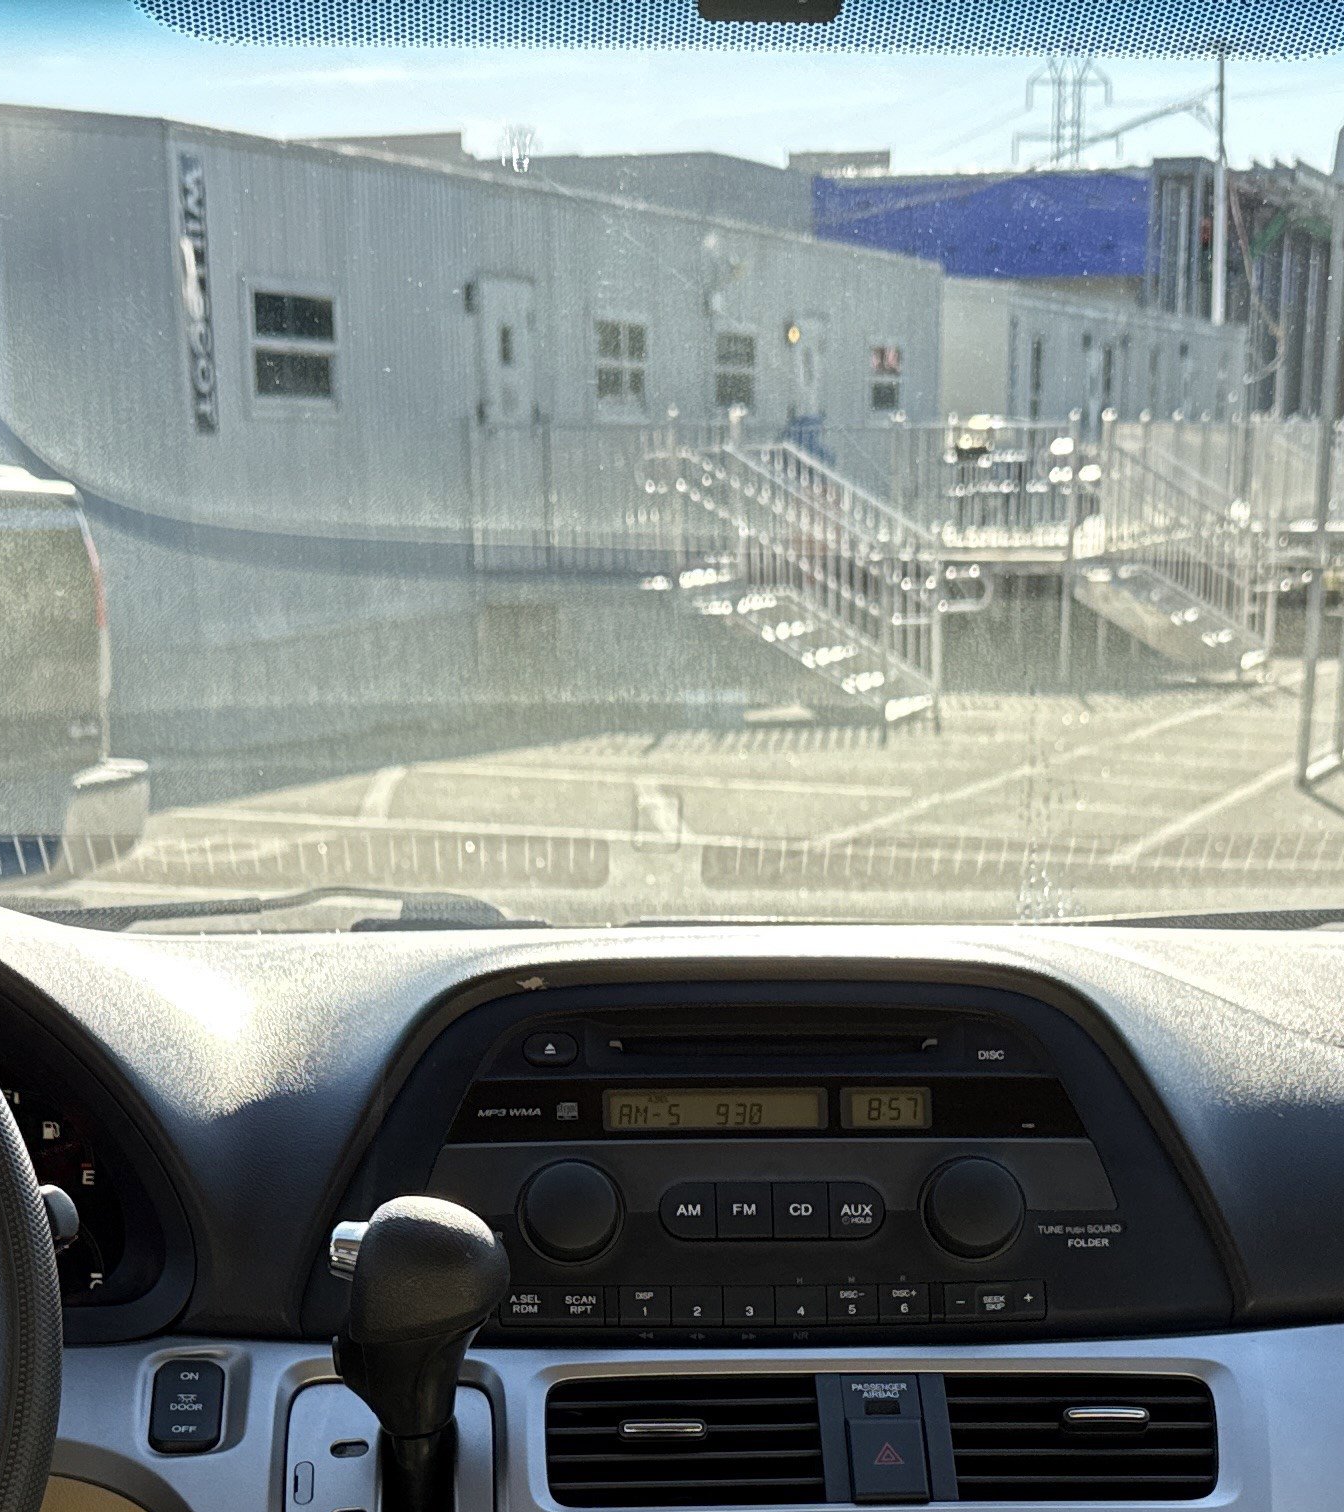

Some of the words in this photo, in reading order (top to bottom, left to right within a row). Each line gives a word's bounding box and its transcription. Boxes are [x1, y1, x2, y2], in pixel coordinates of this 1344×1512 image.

[978, 1049, 1005, 1060] DISC
[477, 1108, 506, 1118] MP3
[509, 1107, 542, 1118] WMA
[716, 1102, 764, 1126] 930
[867, 1097, 919, 1121] 8:57
[82, 1169, 95, 1186] E
[676, 1204, 702, 1216] AM
[732, 1203, 756, 1216] FM
[789, 1203, 813, 1216] CD
[840, 1203, 873, 1216] AUX
[850, 1216, 873, 1224] HOLD
[1038, 1224, 1064, 1235] TUNE
[1065, 1226, 1086, 1235] PUSH
[1087, 1223, 1122, 1234] SOUND
[1068, 1237, 1110, 1248] FOLDER
[565, 1295, 597, 1304] SCAN
[635, 1291, 654, 1300] DISP
[512, 1304, 539, 1314] RDM
[569, 1305, 593, 1315] RPT
[642, 1307, 648, 1316] 1
[692, 1306, 702, 1317] 2
[744, 1306, 754, 1317] 3
[796, 1305, 805, 1316] 4
[848, 1304, 857, 1315] 5
[900, 1303, 909, 1314] 6
[985, 1302, 1006, 1311] SKIP
[180, 1371, 200, 1381] ON
[851, 1383, 907, 1391] PASSENGER
[862, 1391, 900, 1399] AIRBAG
[169, 1402, 204, 1412] DOOR
[171, 1425, 197, 1433] OFF
